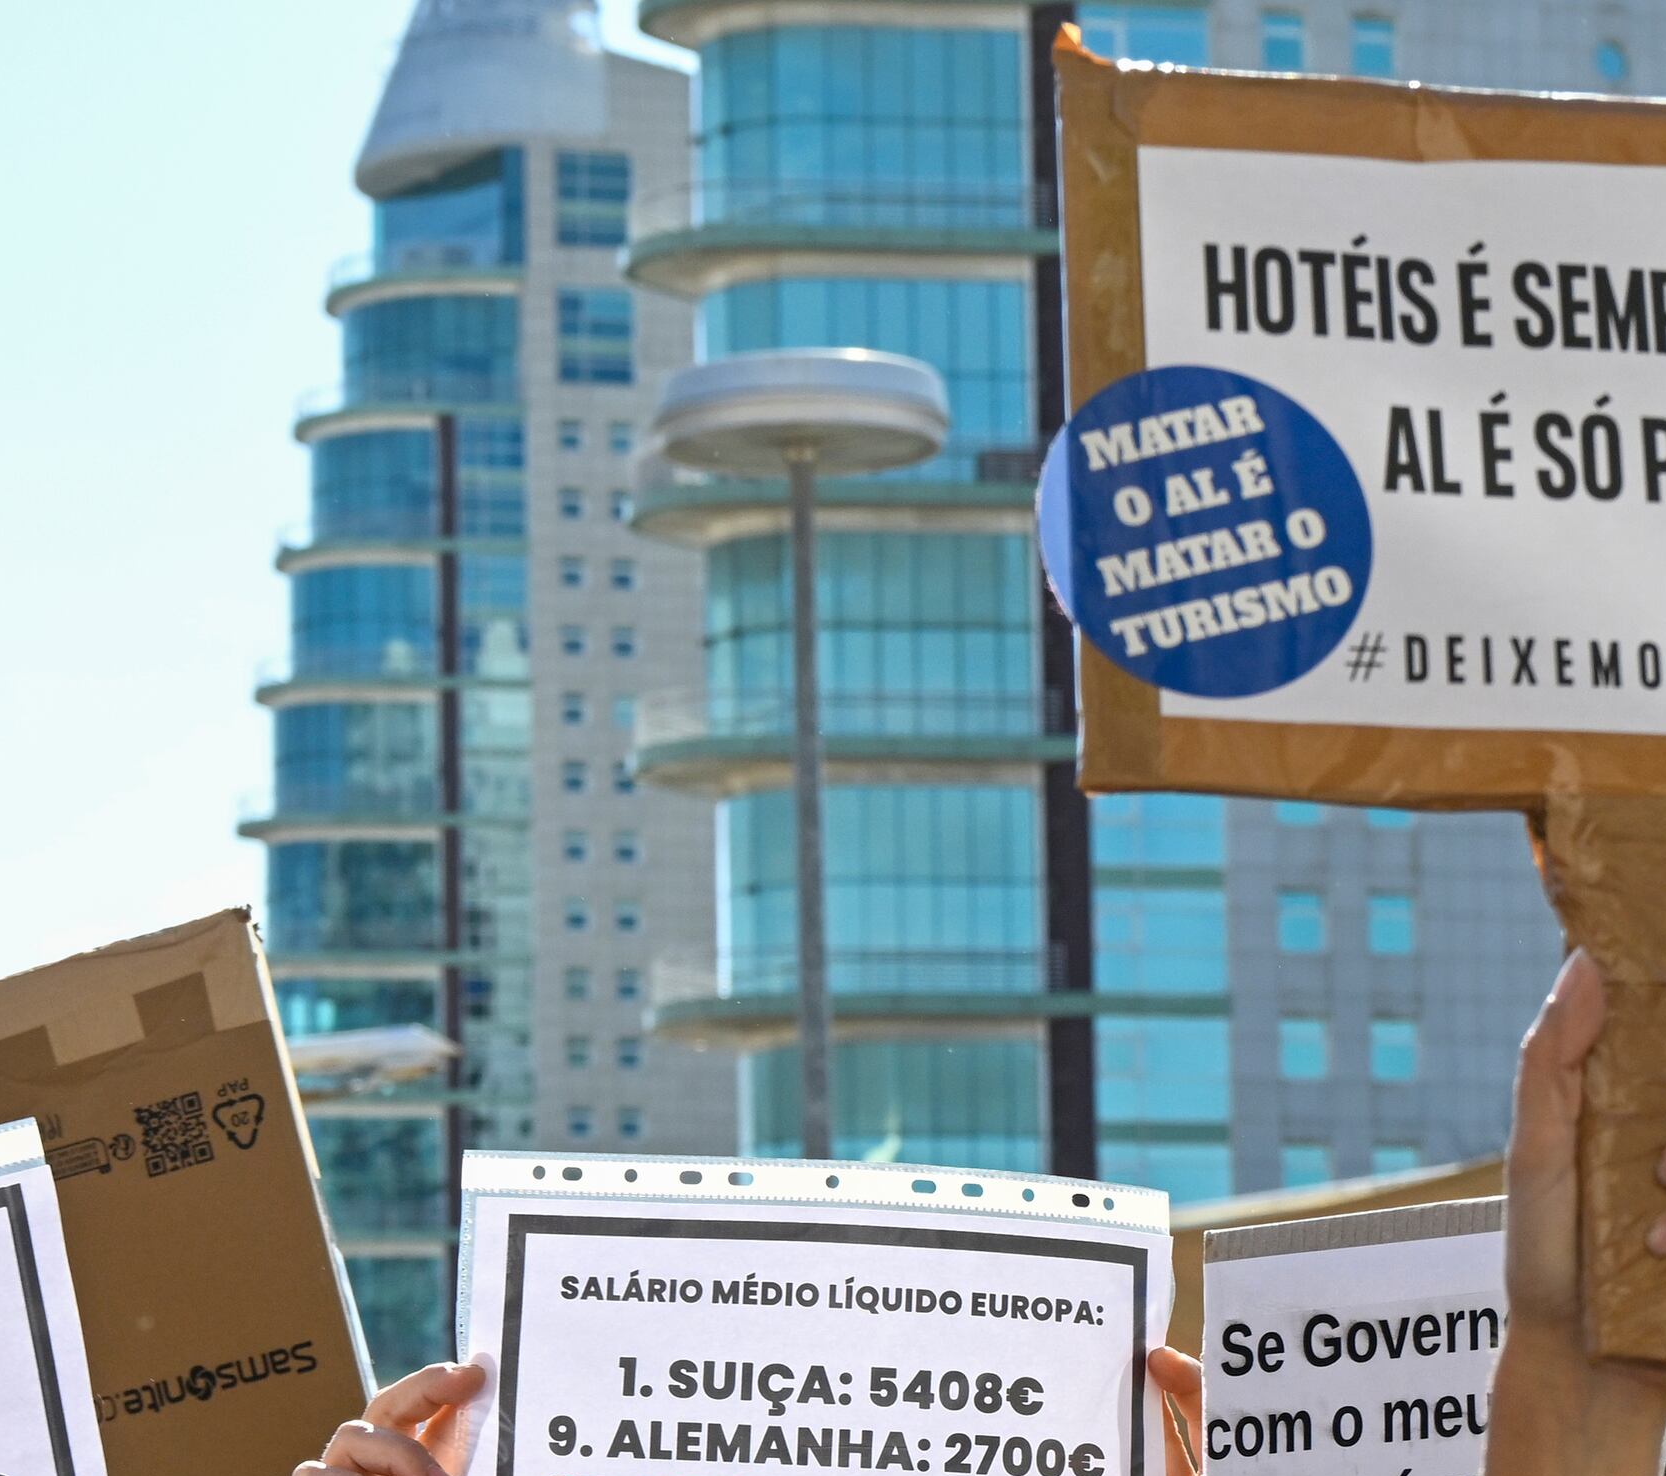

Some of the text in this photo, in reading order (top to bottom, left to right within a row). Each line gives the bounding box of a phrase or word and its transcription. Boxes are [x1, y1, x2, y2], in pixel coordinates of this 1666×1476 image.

[1204, 235, 1439, 345] HOTÉIS
[1457, 241, 1493, 348] É
[1080, 394, 1265, 472] MATAR
[1384, 406, 1462, 495] AL
[1479, 392, 1514, 497] É
[1534, 395, 1623, 501] SÓ
[1113, 449, 1274, 527] O AL É
[1096, 507, 1326, 598] MATAR O
[1110, 565, 1353, 657] TURISMO
[560, 1269, 1104, 1326] SALÁRIO MÉDIO LÍQUIDO EUROPA:
[1220, 1307, 1507, 1377] Se Govern
[619, 1356, 1044, 1416] 1. SUIÇA: 5408€
[547, 1415, 593, 1457] 9.
[607, 1419, 931, 1473] ALEMANHA:
[1207, 1393, 1491, 1461] com o meu
